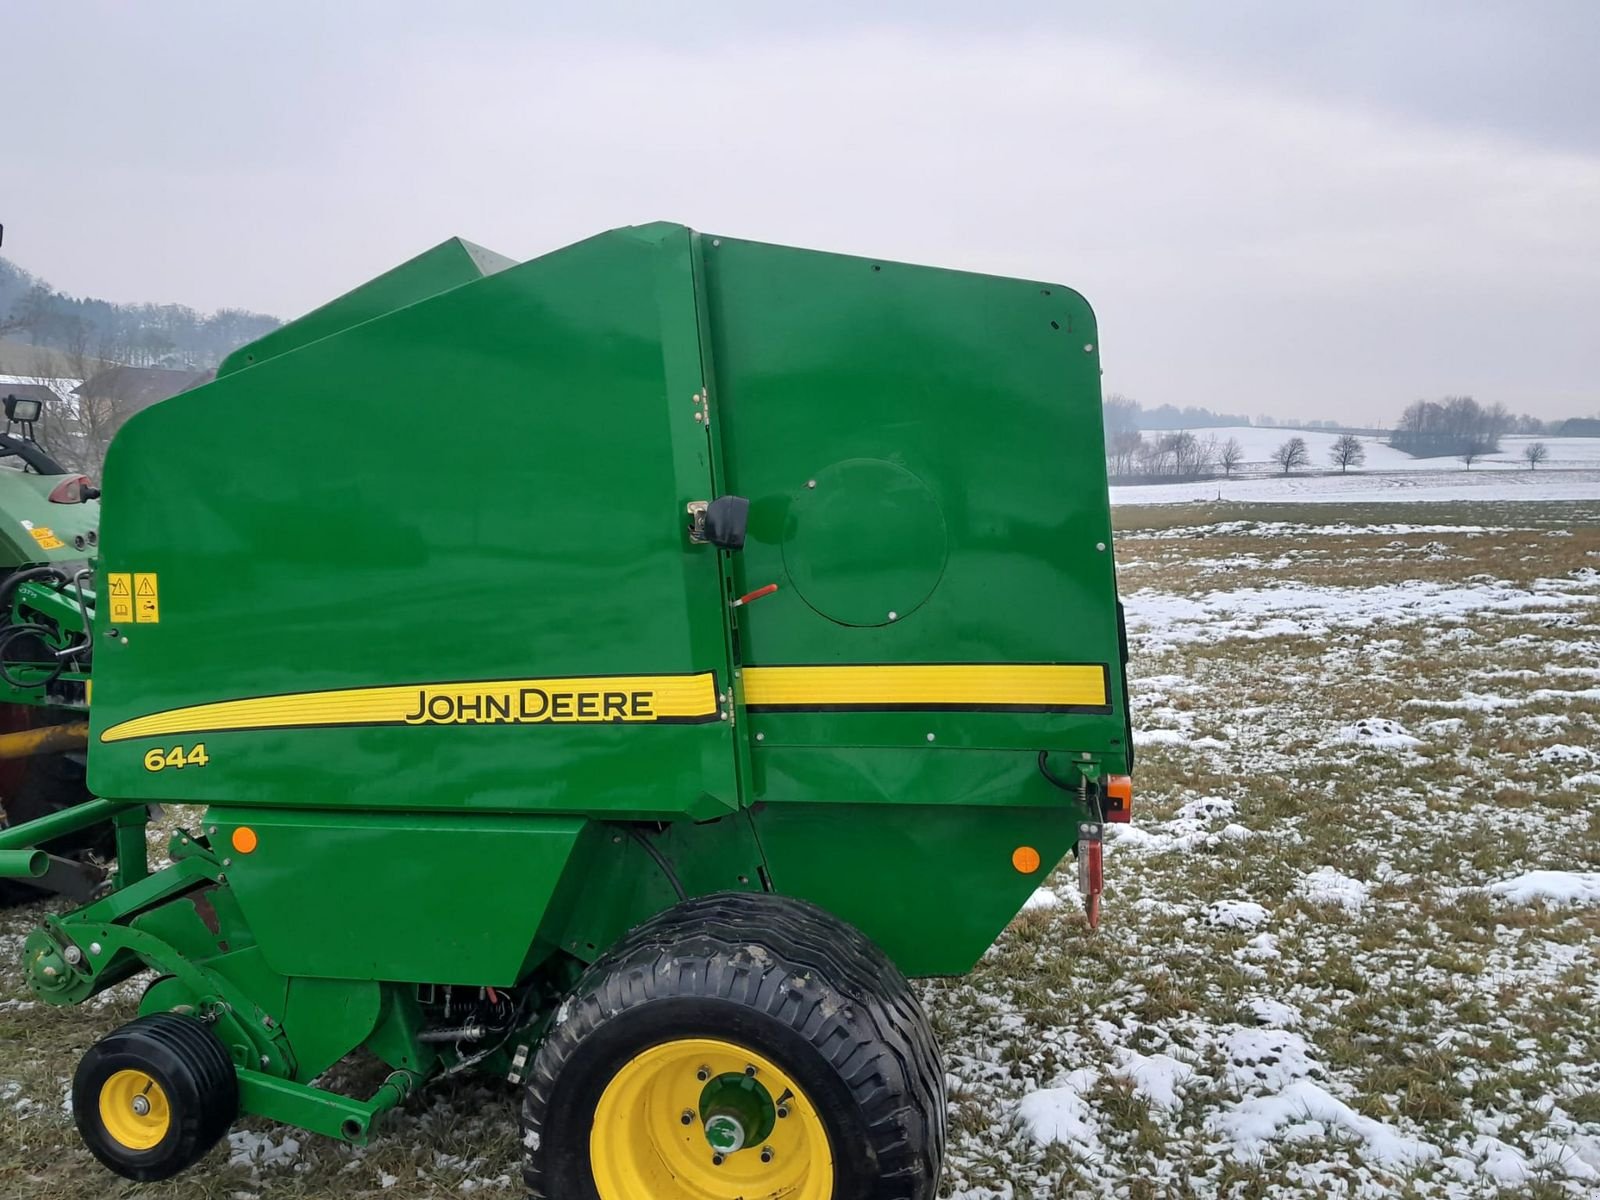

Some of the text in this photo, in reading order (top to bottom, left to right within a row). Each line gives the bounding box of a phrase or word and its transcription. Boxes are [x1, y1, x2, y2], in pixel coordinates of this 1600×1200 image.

[405, 688, 655, 721] JOHN DEERE
[144, 743, 209, 772] 644
